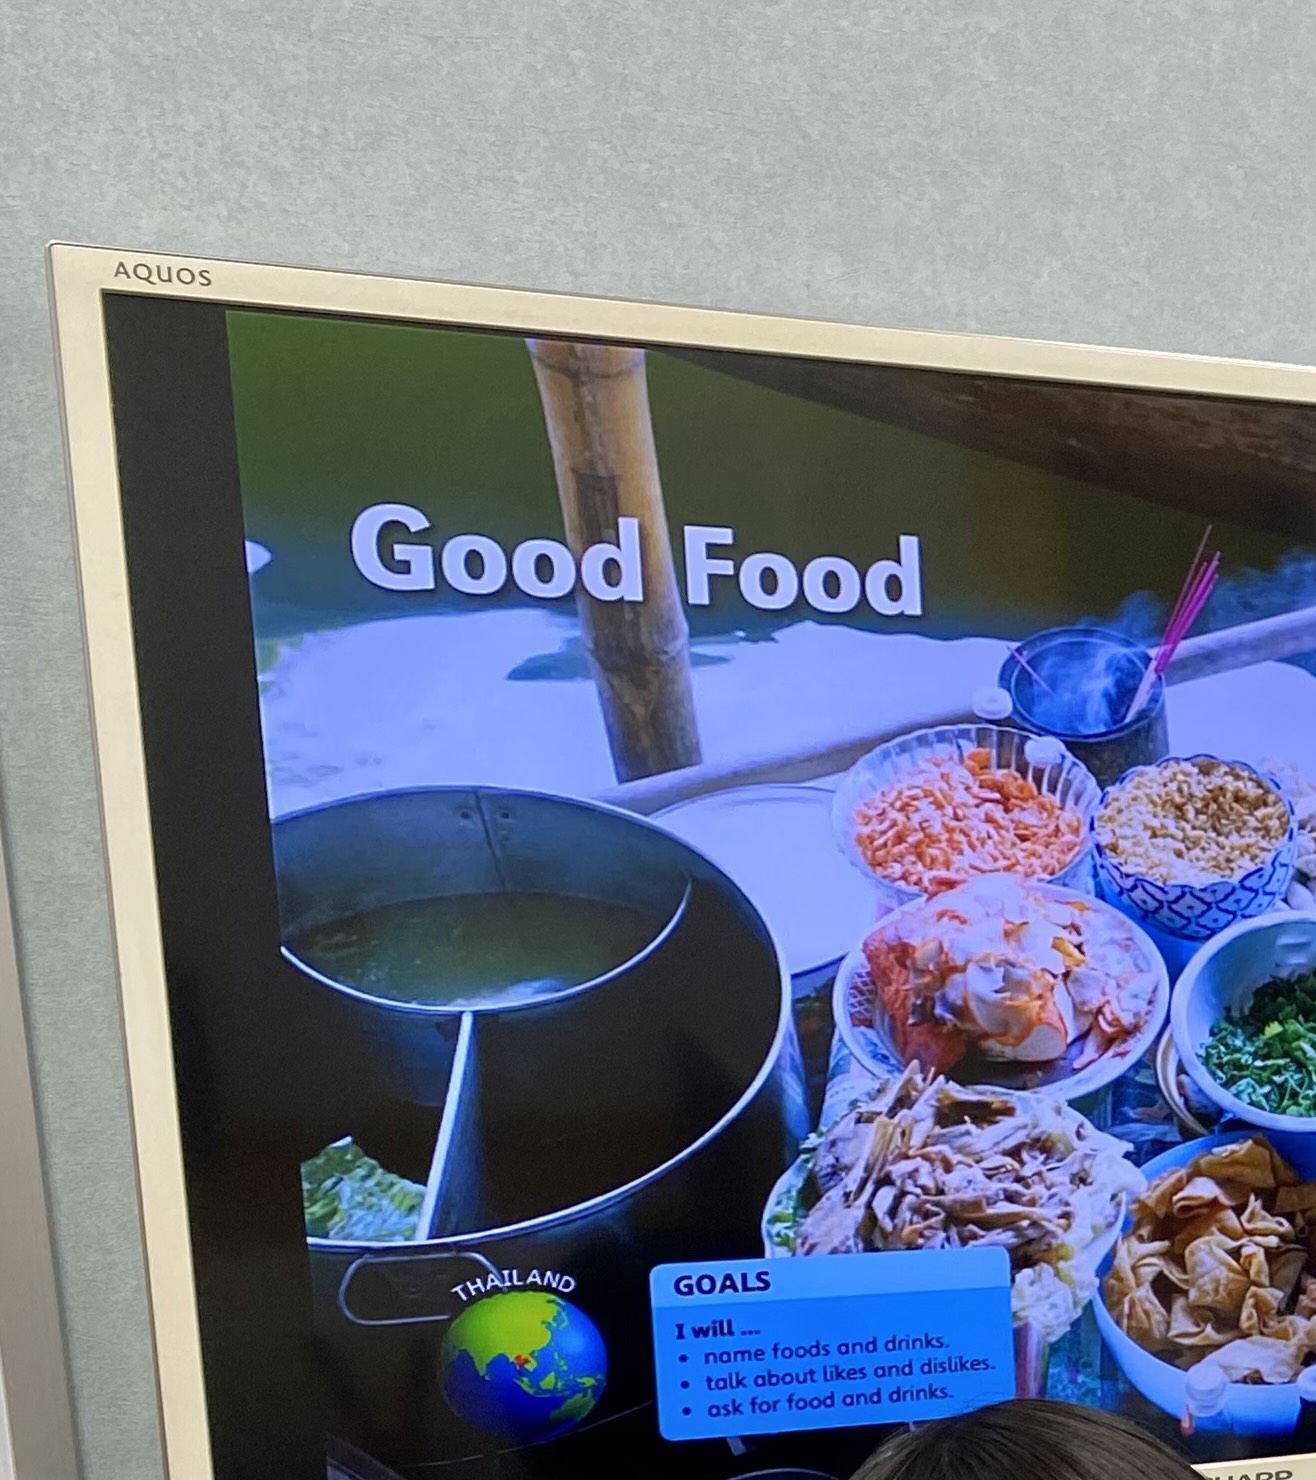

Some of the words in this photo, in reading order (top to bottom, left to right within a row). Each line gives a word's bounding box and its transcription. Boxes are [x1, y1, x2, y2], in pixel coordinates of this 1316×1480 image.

[114, 261, 212, 287] AQUOS
[350, 503, 644, 602] Good
[684, 525, 924, 617] Food
[450, 1269, 576, 1301] THAILAND
[674, 1271, 771, 1296] GOALS
[675, 1323, 686, 1340] I
[691, 1319, 734, 1339] will
[704, 1348, 766, 1365] name
[772, 1340, 831, 1360] foods
[837, 1336, 877, 1355] and
[884, 1332, 950, 1352] drinks.
[706, 1372, 747, 1391] talk
[753, 1369, 817, 1387] about
[823, 1365, 867, 1382] likes
[873, 1359, 913, 1378] and
[920, 1355, 996, 1375] dislikes.
[707, 1398, 744, 1417] ask
[751, 1396, 780, 1414] for
[787, 1391, 835, 1411] food
[842, 1387, 881, 1407] and
[889, 1384, 954, 1403] drinks.
